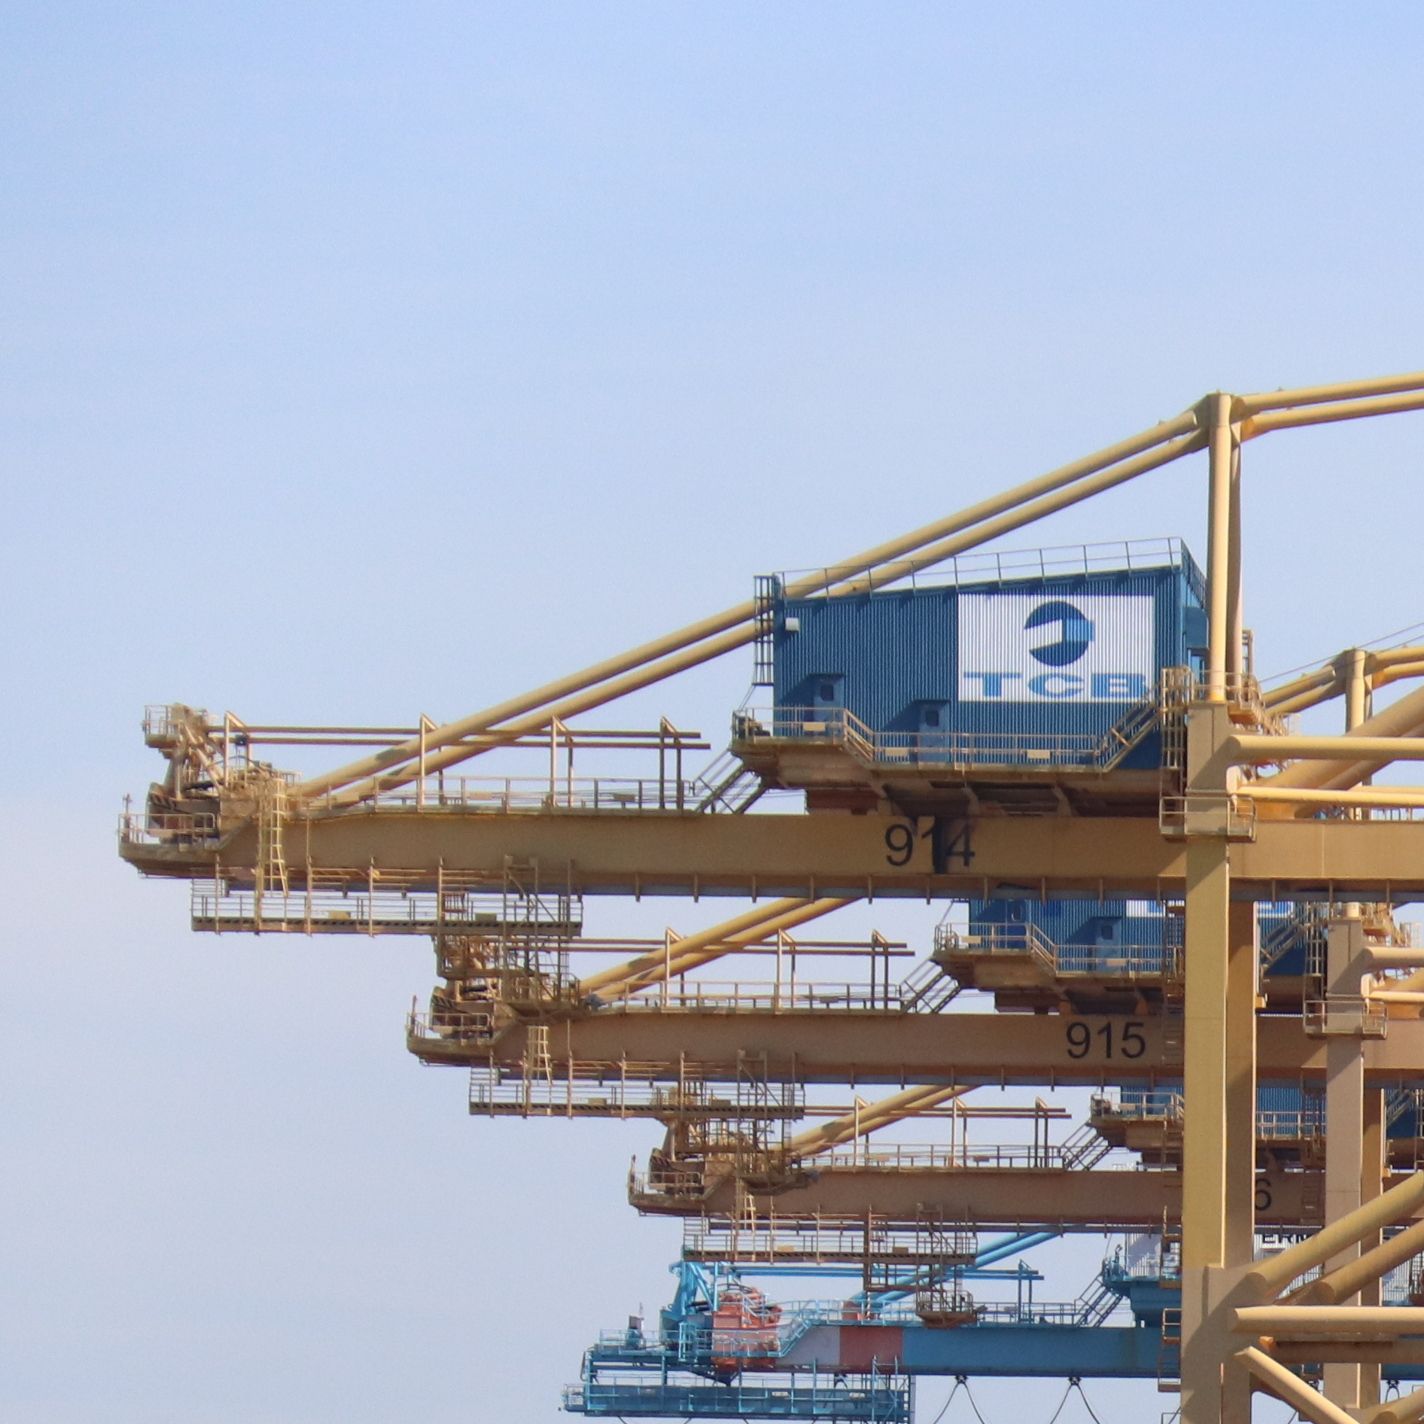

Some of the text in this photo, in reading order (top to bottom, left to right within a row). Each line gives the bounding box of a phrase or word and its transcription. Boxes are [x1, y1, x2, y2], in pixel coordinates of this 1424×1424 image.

[962, 671, 1149, 698] TCB
[884, 824, 975, 868] 914
[1066, 1021, 1146, 1059] 915
